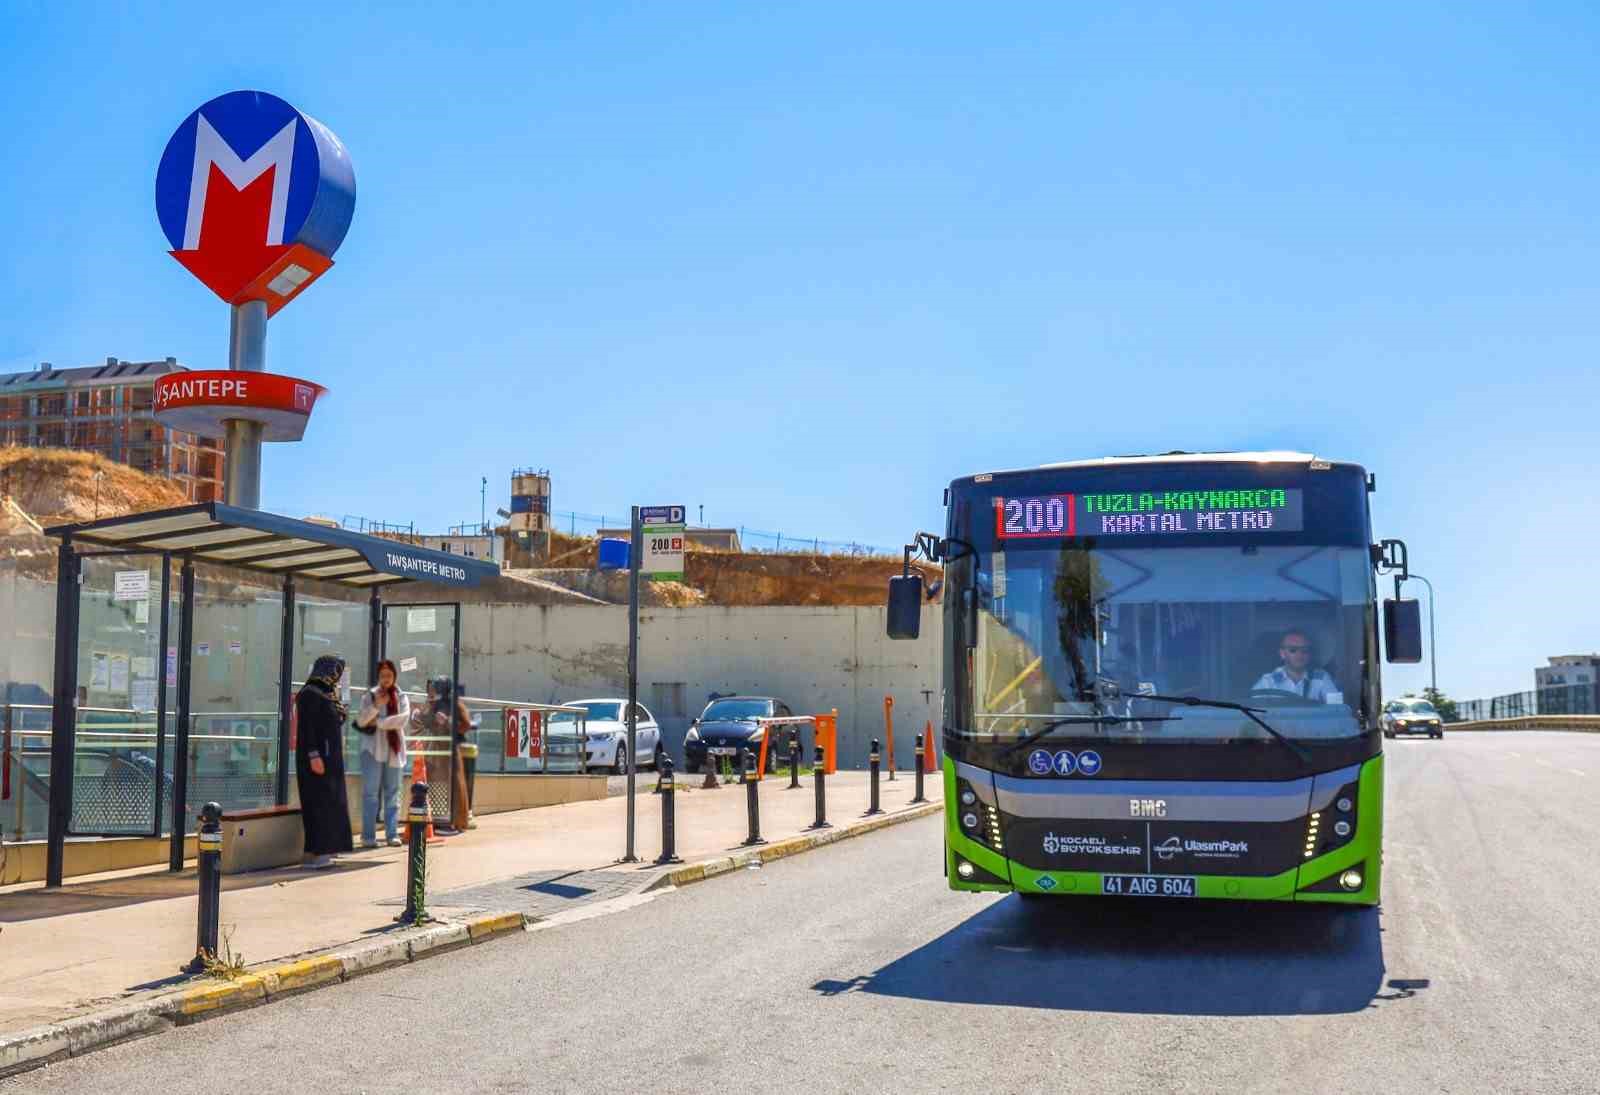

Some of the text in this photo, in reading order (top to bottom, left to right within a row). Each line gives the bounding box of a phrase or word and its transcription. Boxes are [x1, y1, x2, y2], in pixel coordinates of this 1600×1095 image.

[183, 112, 298, 251] M
[153, 379, 248, 407] VŞANTEPE
[1083, 489, 1285, 513] TUZLA-KAYNARCA
[1005, 498, 1064, 533] 200
[1102, 511, 1273, 533] KARTAL METRO
[386, 552, 466, 581] TAVŞANTEPE METRO
[1129, 799, 1167, 817] BMC
[1106, 877, 1193, 895] 41 AIG 604
